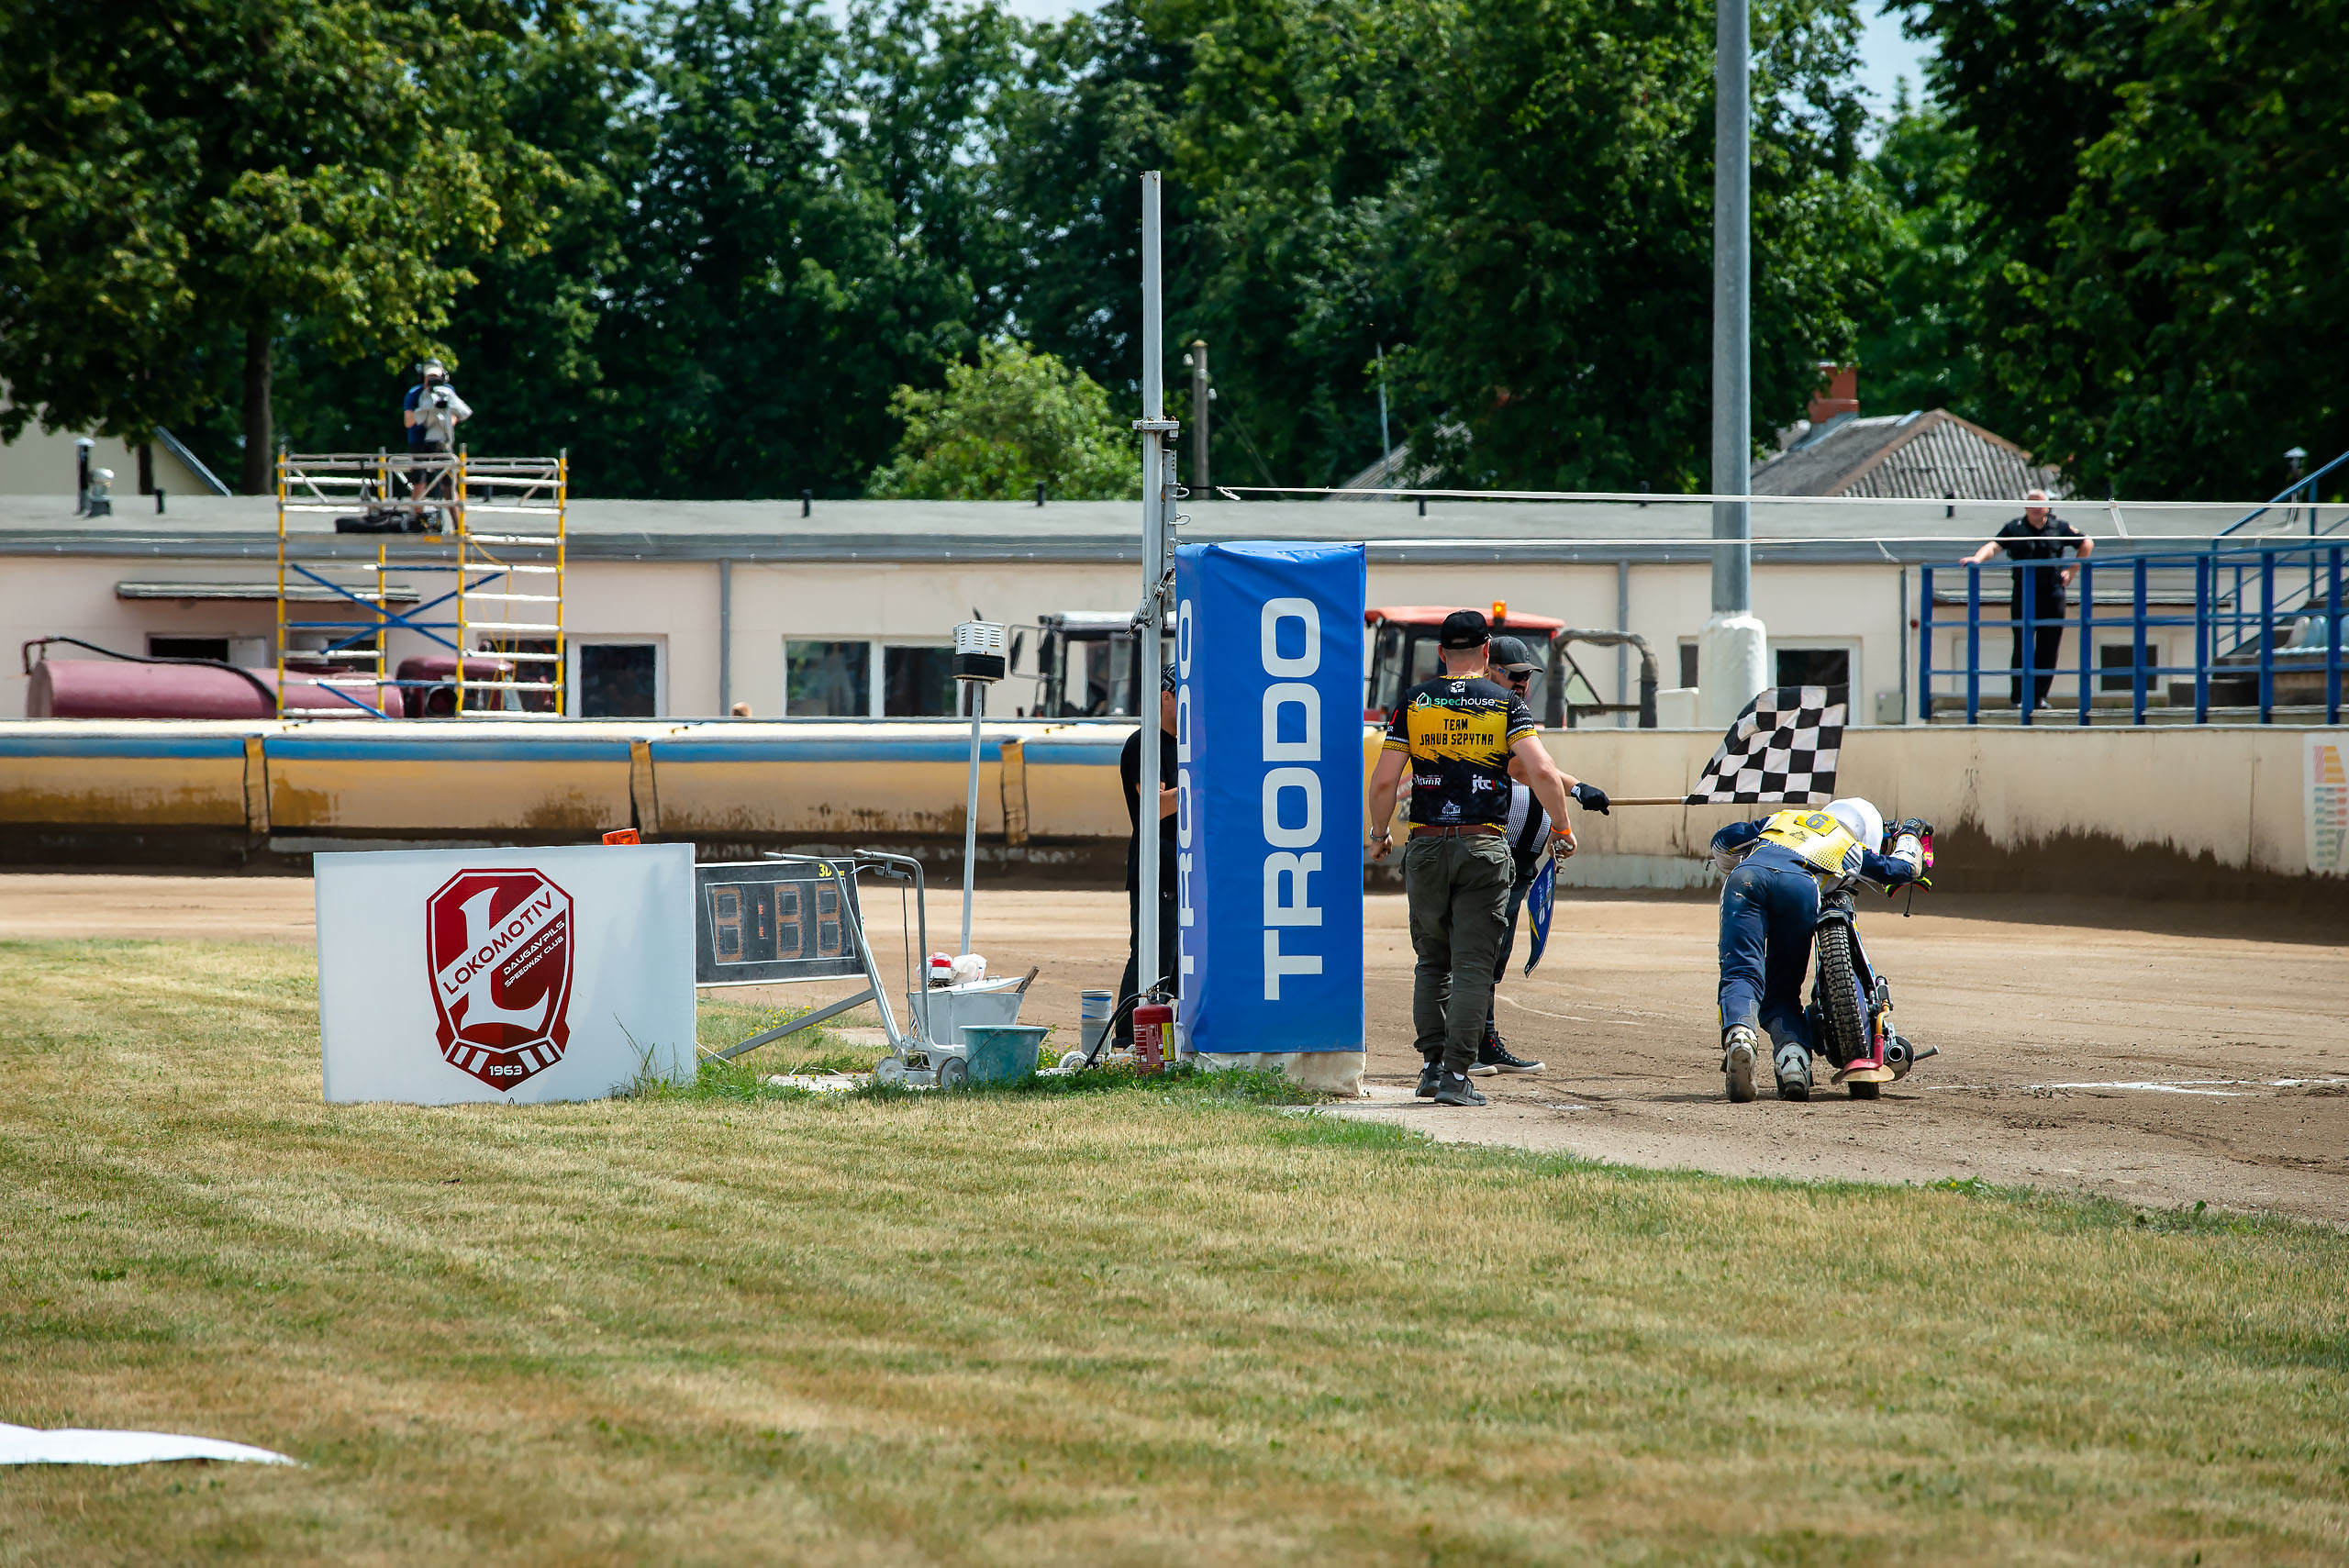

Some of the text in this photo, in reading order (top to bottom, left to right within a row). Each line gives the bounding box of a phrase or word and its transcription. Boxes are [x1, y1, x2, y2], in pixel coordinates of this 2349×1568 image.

[1443, 718, 1468, 730] TEAM
[1178, 599, 1194, 1000] TRODO
[1262, 597, 1322, 1000] TRODO
[1805, 814, 1829, 828] 6
[442, 890, 552, 995] LOKOMOTIV
[503, 920, 565, 975] DAUGAVPILS
[504, 936, 564, 988] SPEEDWAY CLUB
[488, 1065, 523, 1076] 1963
